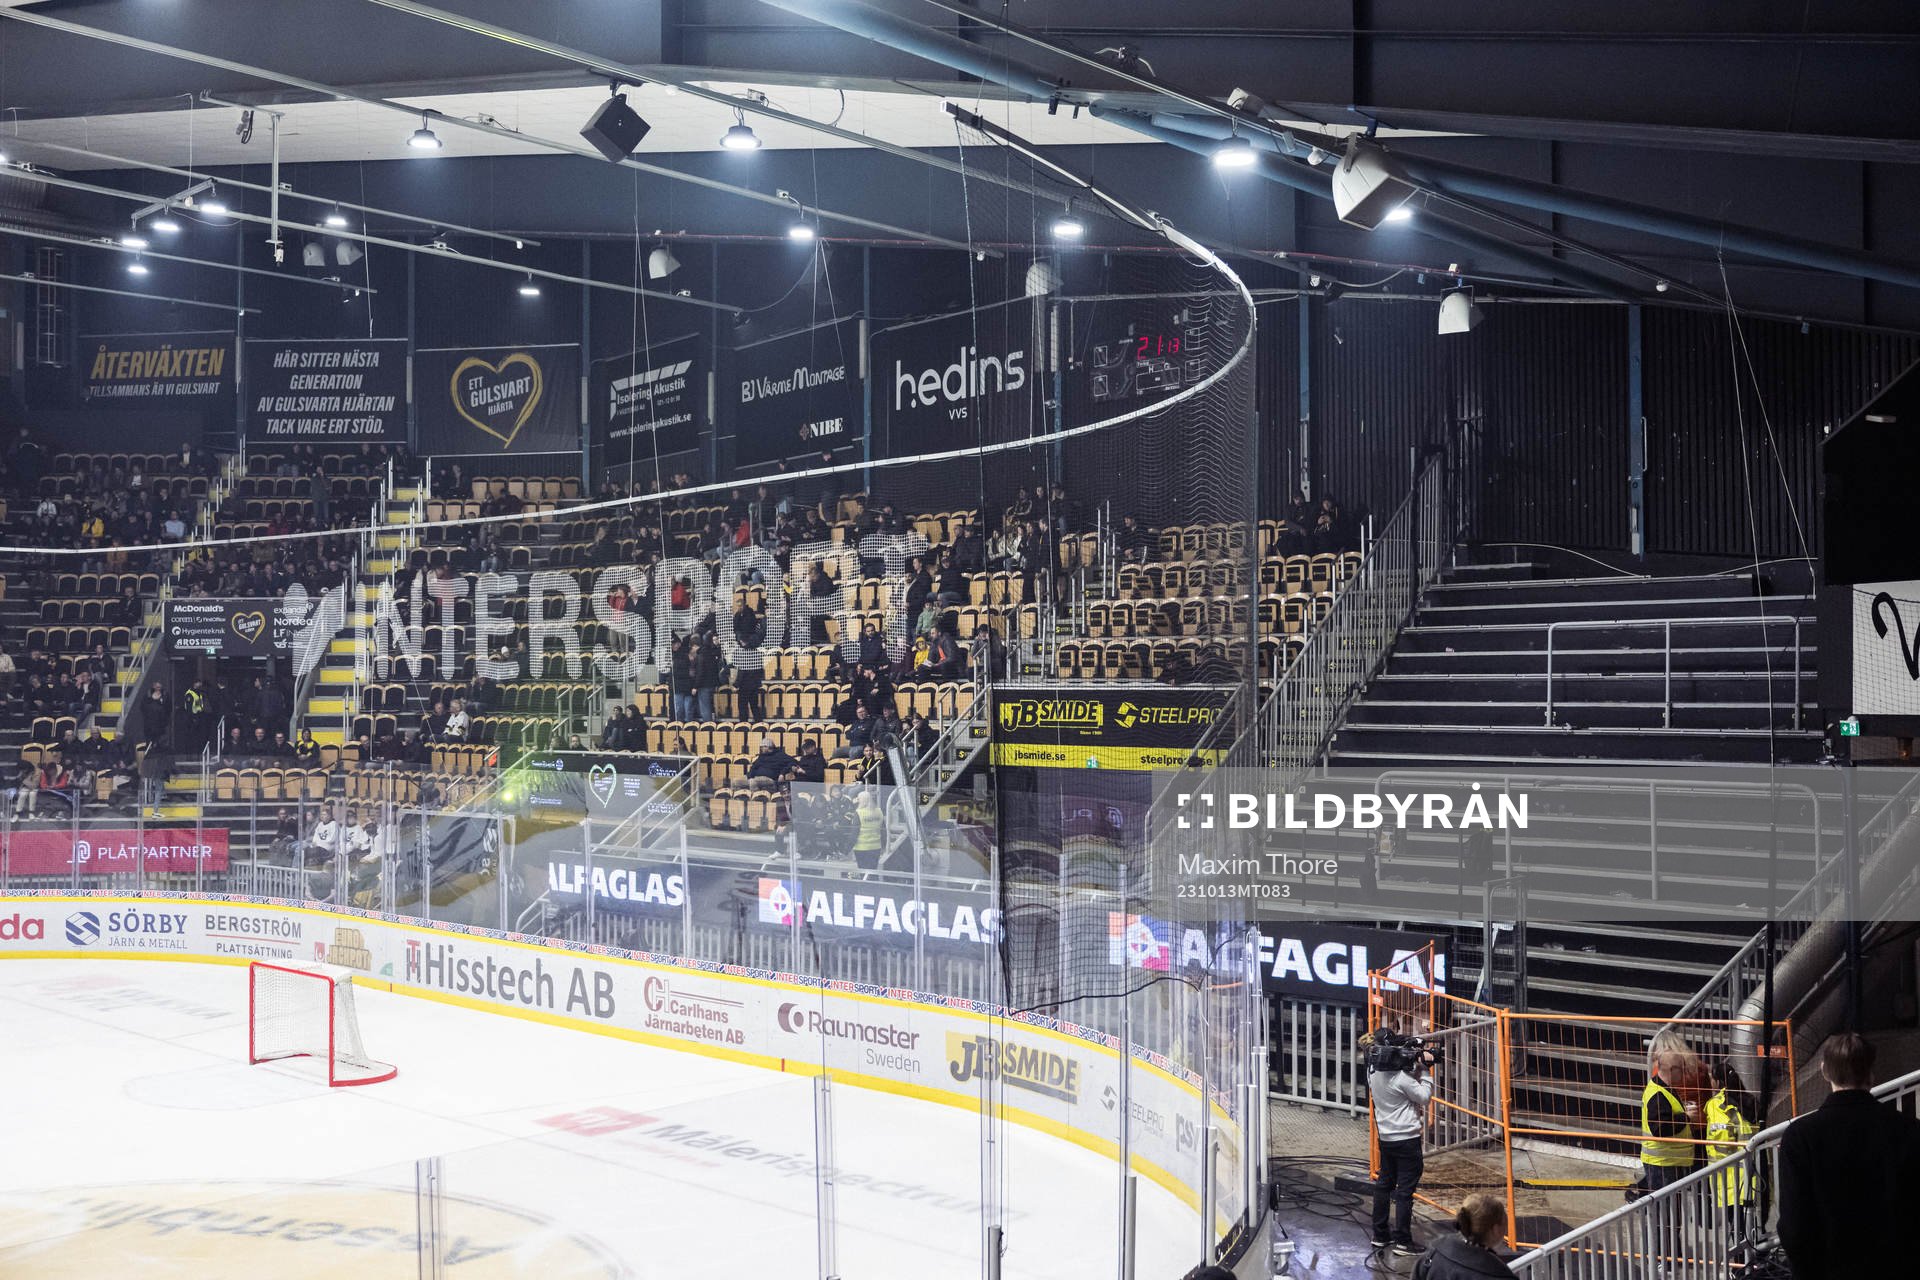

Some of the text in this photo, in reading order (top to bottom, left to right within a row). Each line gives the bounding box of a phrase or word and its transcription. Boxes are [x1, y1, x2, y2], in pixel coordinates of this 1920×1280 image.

[90, 344, 225, 380] ÅTERVÄXTEN
[273, 349, 380, 368] HÄR SITTER NÄSTA
[289, 374, 363, 390] GENERATION
[468, 376, 484, 391] ETT
[896, 345, 1025, 411] hedins
[90, 382, 221, 397] TILLSAMMANS ÄR VI GULSVART
[470, 376, 531, 408] GULSVART
[617, 387, 652, 405] Isolering
[653, 377, 687, 396] Akustik
[257, 393, 396, 412] AV GULSVARTA HJÄRTAN
[488, 400, 514, 416] HJÄRTA
[266, 415, 386, 434] TACK VARE ERT STÖD.
[609, 413, 693, 439] www.isoleringakustik.se
[810, 417, 843, 438] NIBE
[173, 605, 225, 613] McDonald's
[354, 532, 930, 684] INTERSPORT
[273, 617, 313, 626] Nordea
[176, 638, 200, 646] AROS
[1015, 751, 1066, 762] jbsmide.se
[98, 844, 213, 860] PLÅTPARTNER
[39, 889, 83, 898] INTERSPORT
[92, 889, 134, 898] INTERSPORT
[142, 890, 181, 899] INTERSPORT
[187, 891, 224, 900] INTERSPORT
[230, 894, 264, 905] INTERSPORT
[270, 897, 301, 908] INTERSPORT
[304, 900, 332, 912] INTERSPORT
[336, 904, 364, 917] INTERSPORT
[108, 908, 188, 935] SÖRBY
[368, 909, 395, 922] INTERSPORT
[400, 915, 429, 927] INTERSPORT
[806, 889, 1004, 944] ALFAGLAS
[205, 914, 301, 938] BERGSTRÖM
[433, 920, 464, 932] INTERSPORT
[469, 926, 503, 939] INTERSPORT
[109, 936, 188, 949] JÄRN & METALL
[507, 932, 541, 945] INTERSPORT
[546, 938, 582, 951] INTERSPORT
[216, 942, 293, 959] PLATTSÄTTNING
[589, 944, 625, 958] INTERSPORT
[631, 950, 670, 963] INTERSPORT
[677, 956, 717, 971] INTERSPORT
[725, 964, 768, 979] INTERSPORT
[425, 942, 616, 1019] Hisstech AB
[776, 971, 822, 987] INTERSPORT
[830, 980, 878, 996] INTERSPORT
[888, 988, 937, 1002] INTERSPORT
[670, 1000, 729, 1024] Carlhans
[947, 996, 997, 1014] INTERSPORT
[1003, 1007, 1049, 1028] INTERSPORT
[645, 1014, 744, 1045] Järnarbeten AB
[808, 1011, 920, 1050] Raumaster
[1057, 1018, 1100, 1042] INTERSPORT
[1106, 1033, 1146, 1059] INTEPORT
[866, 1048, 920, 1074] Sweden
